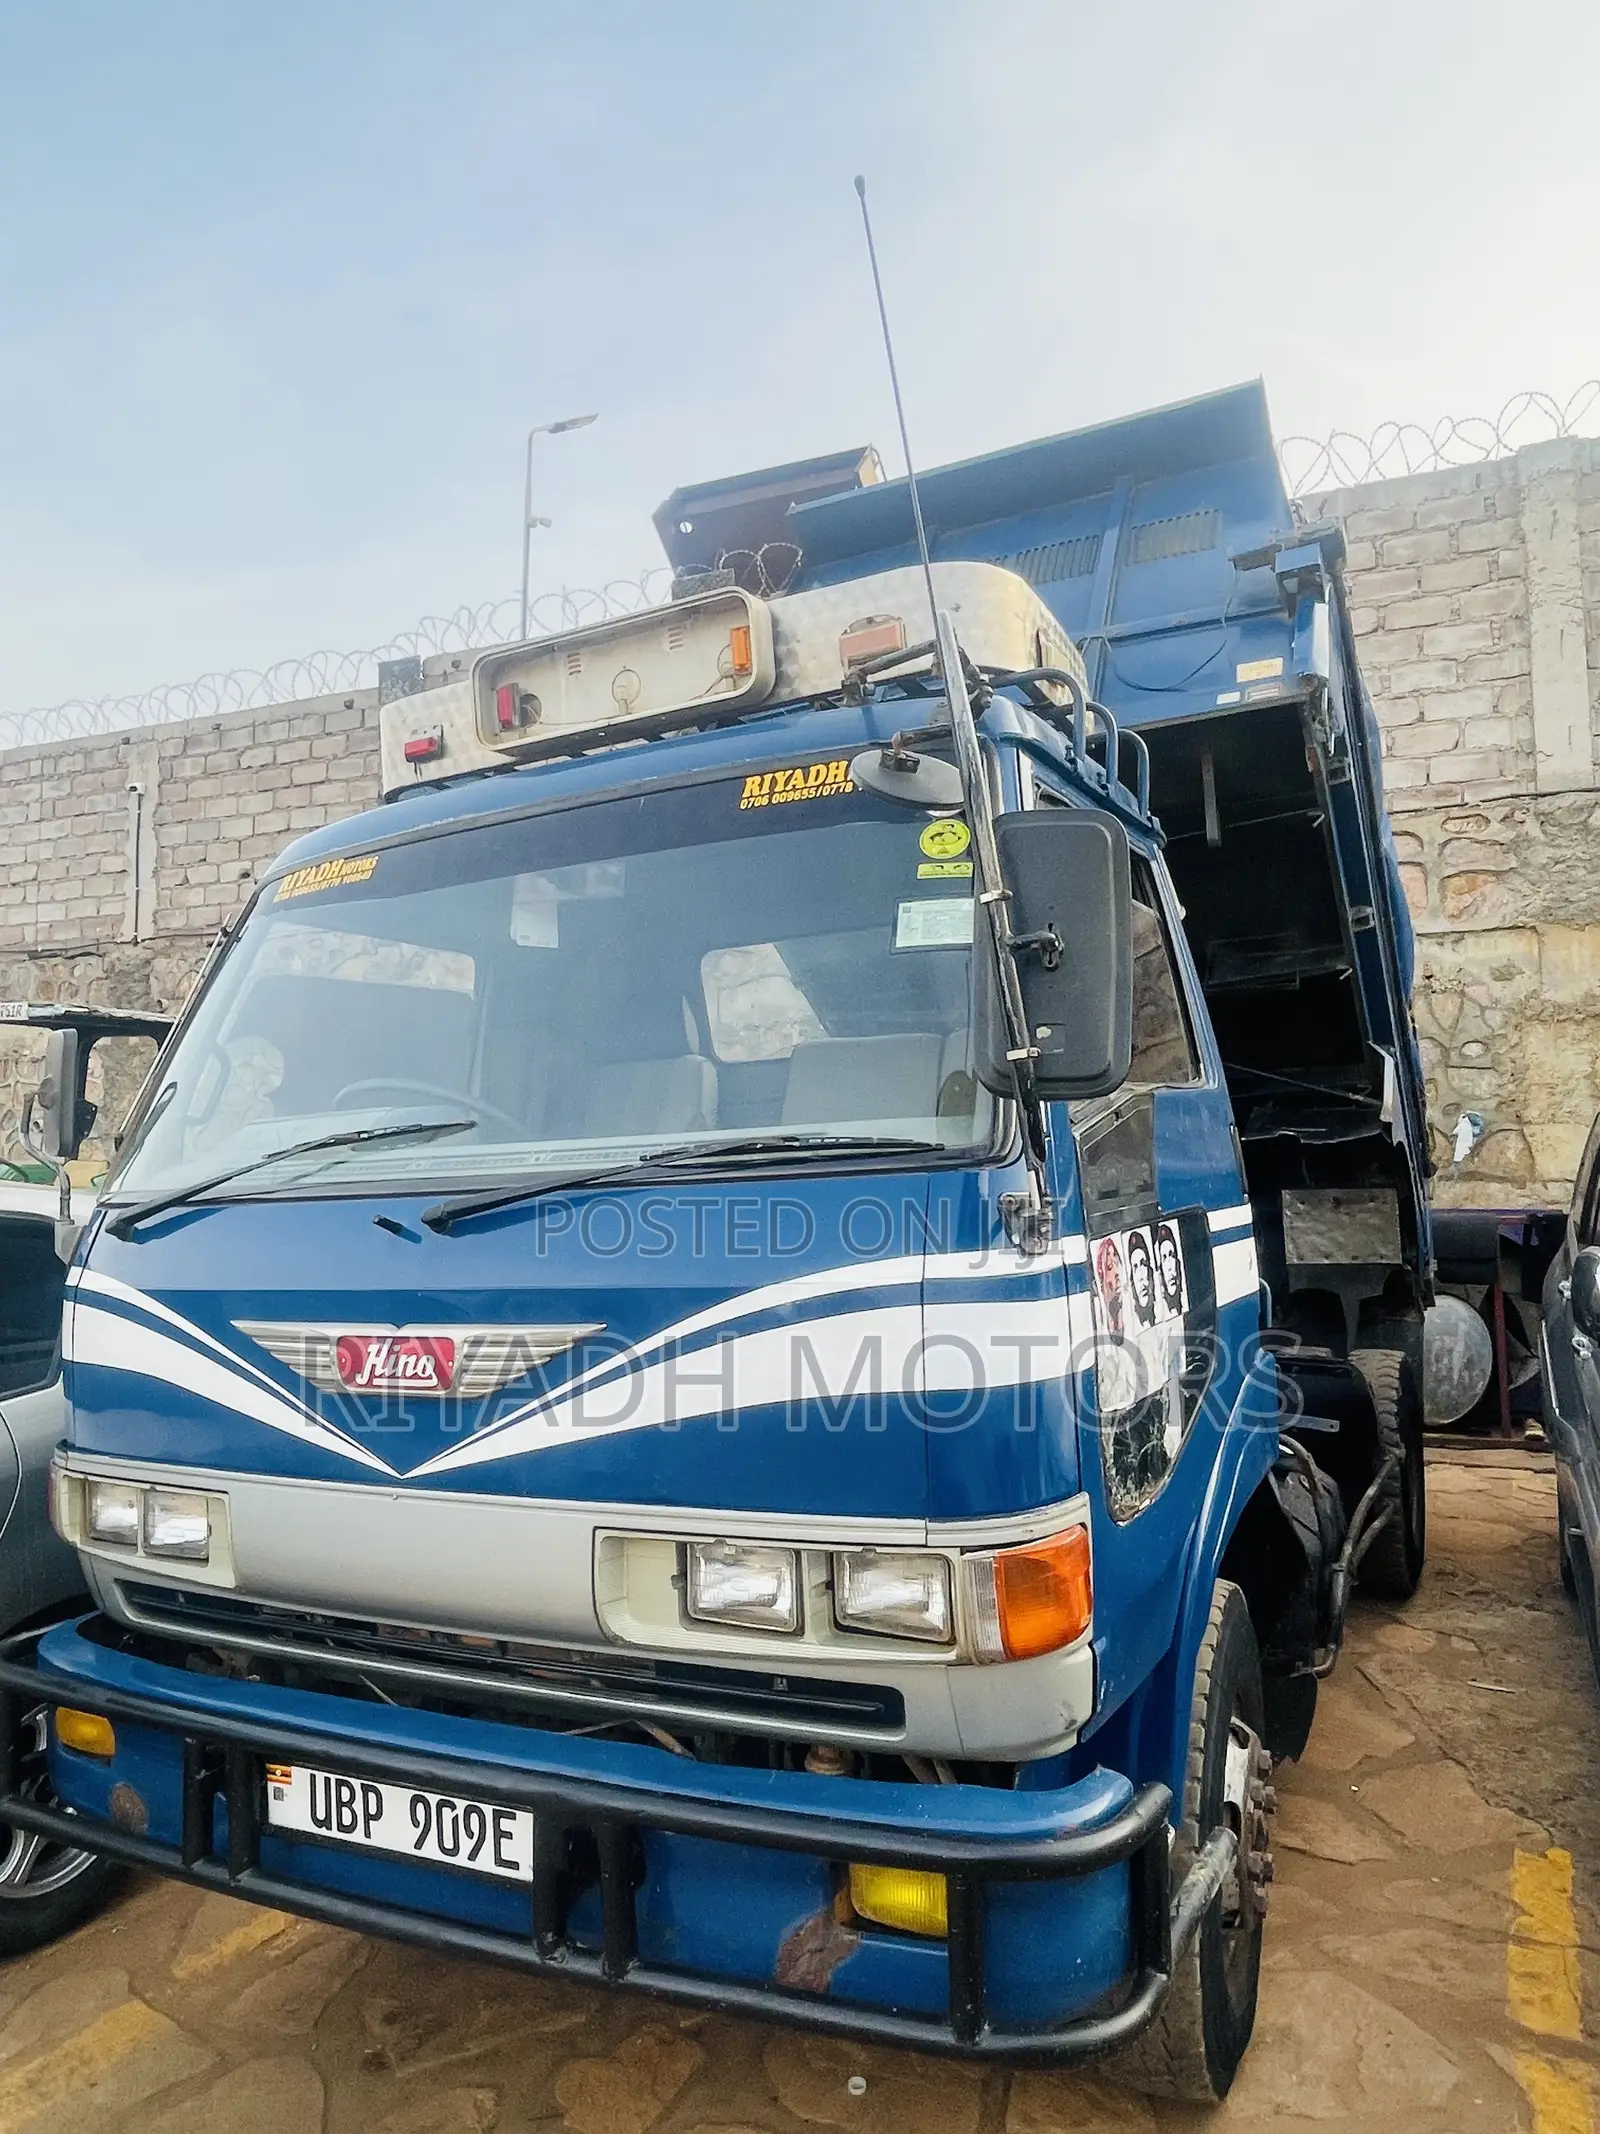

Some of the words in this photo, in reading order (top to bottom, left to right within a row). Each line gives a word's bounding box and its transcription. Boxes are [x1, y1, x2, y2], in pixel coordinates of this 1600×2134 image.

[741, 760, 849, 798] RIYADH
[739, 796, 769, 810] 0706
[277, 858, 345, 893] RIYADH
[355, 1337, 438, 1387] Hino
[309, 1773, 384, 1839] UBP
[409, 1793, 520, 1871] 909E
